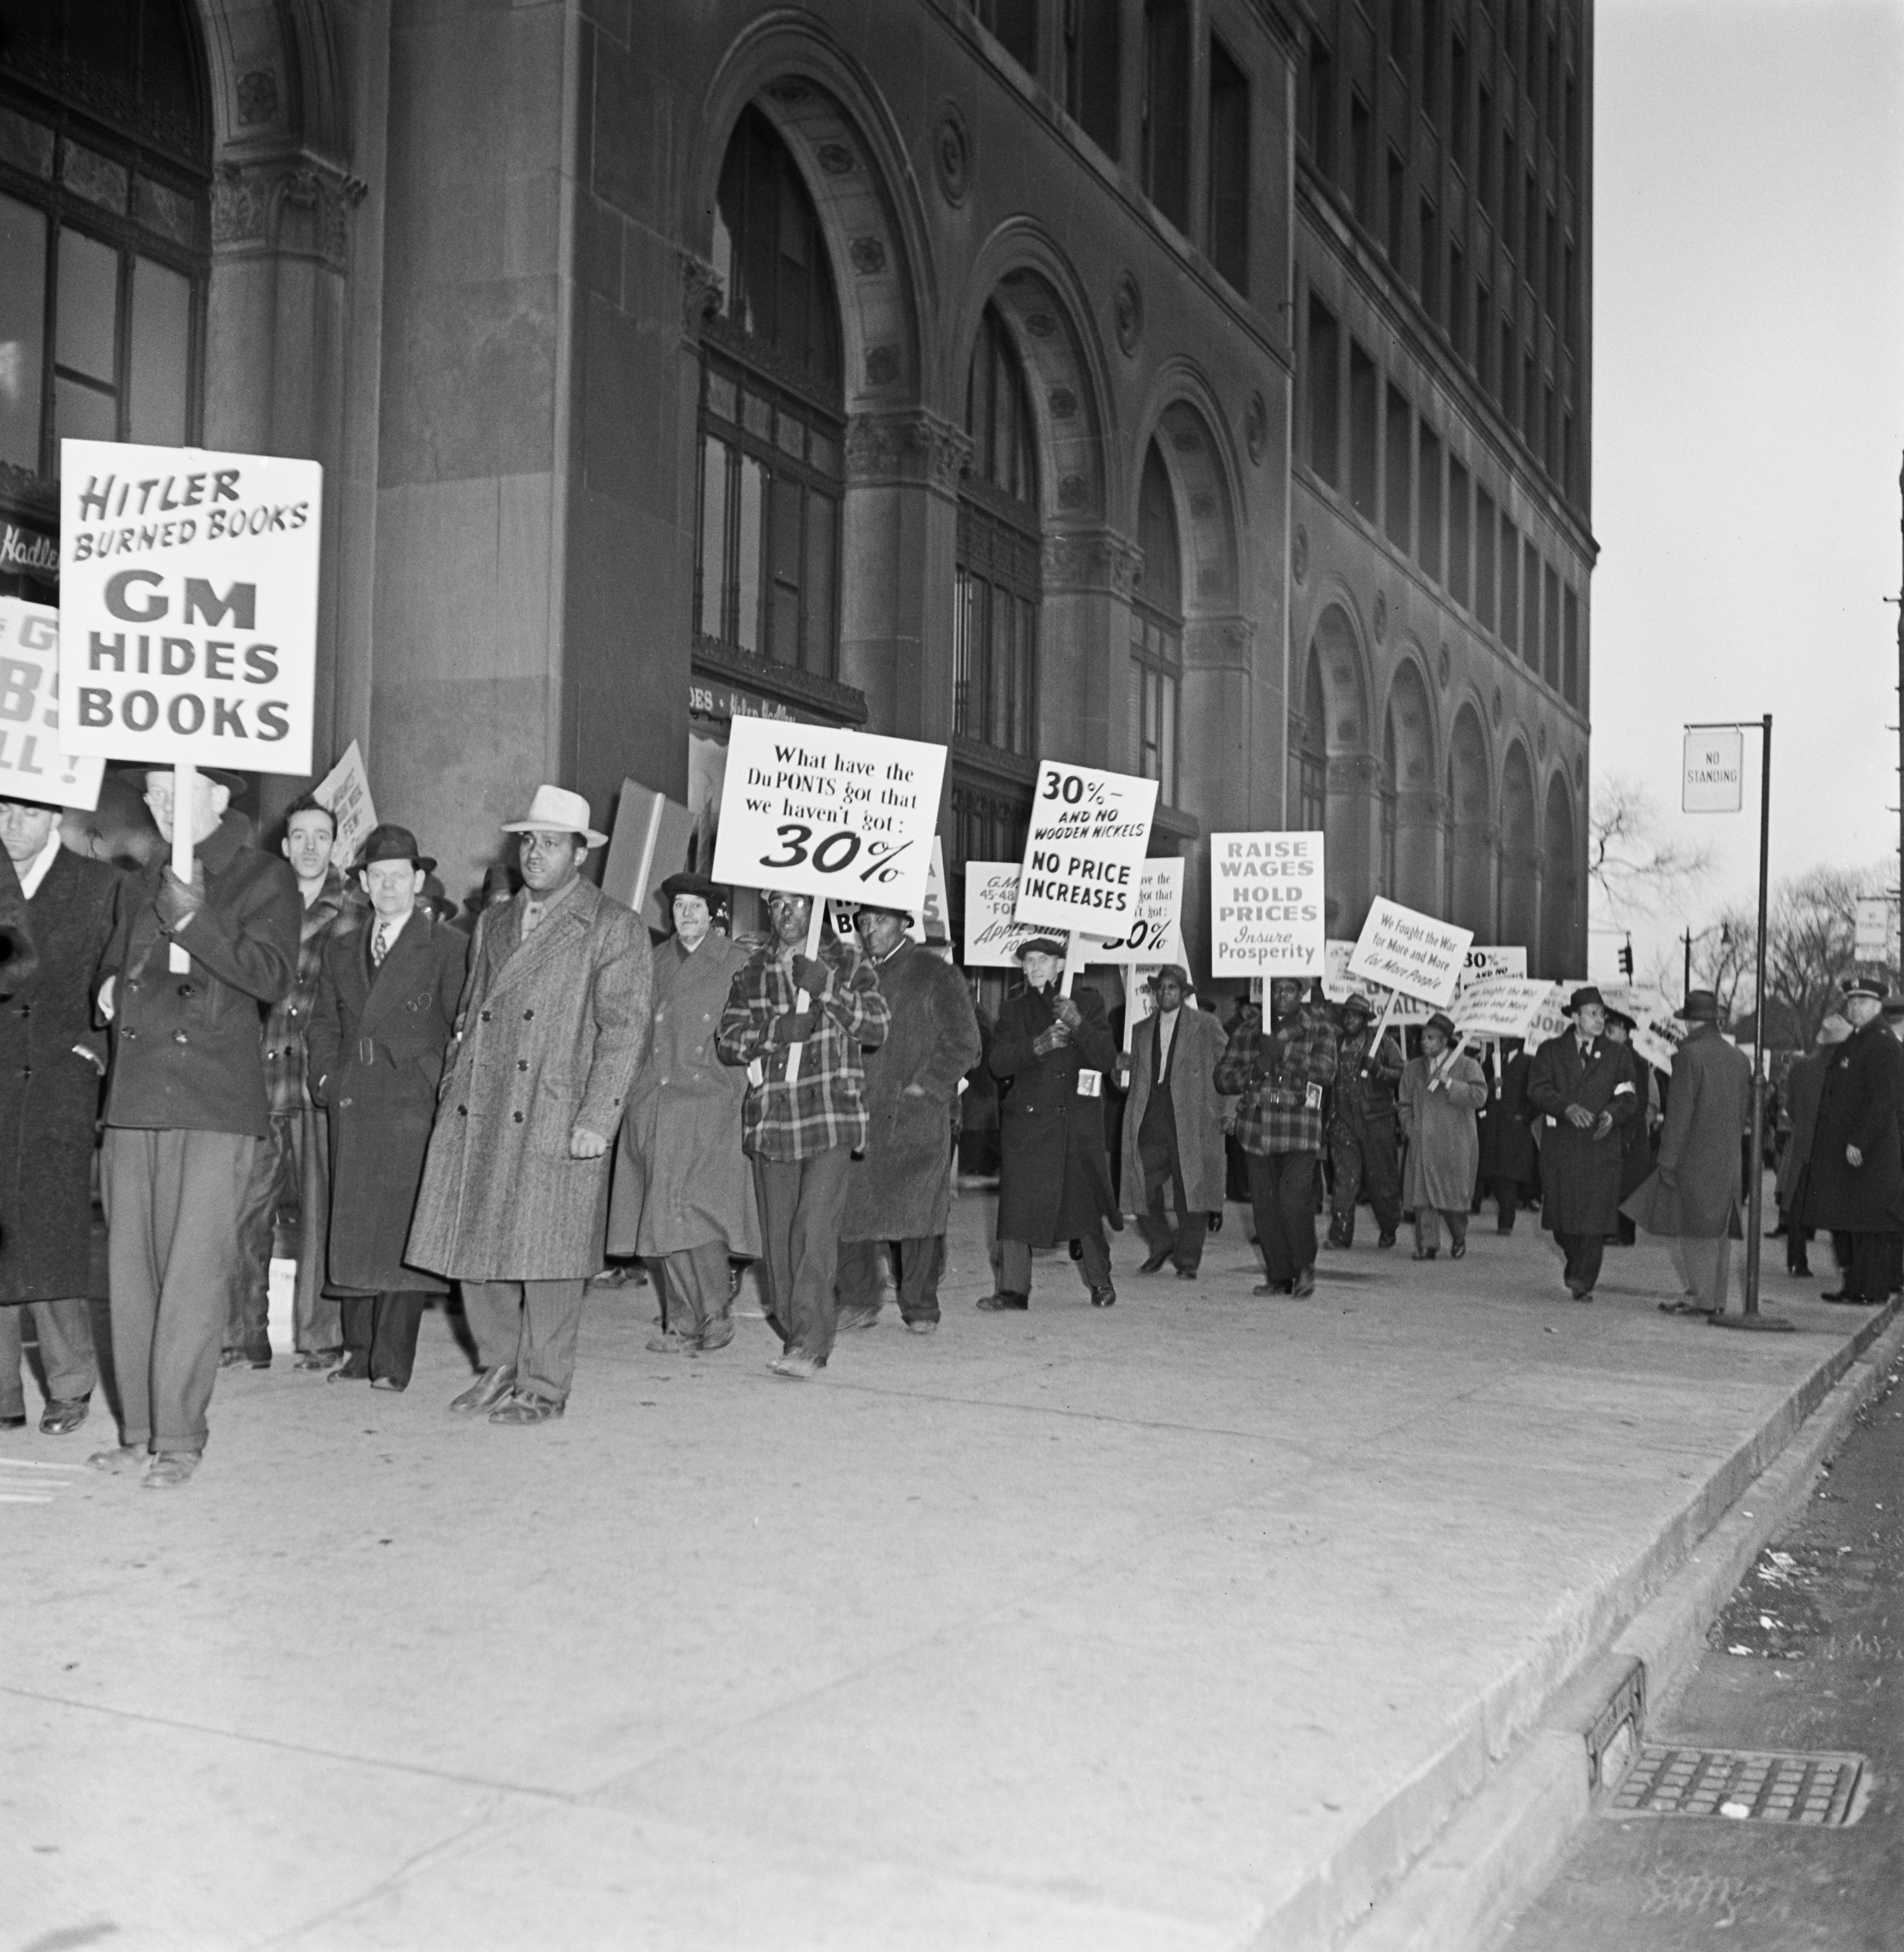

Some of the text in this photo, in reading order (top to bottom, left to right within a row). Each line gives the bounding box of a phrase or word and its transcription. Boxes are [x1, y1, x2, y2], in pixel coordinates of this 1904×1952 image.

[78, 469, 241, 522] HITLER
[73, 501, 309, 563] BURNED BOOKS
[0, 524, 60, 571] Hadle
[103, 569, 257, 631] GM
[88, 631, 280, 684] HIDES
[77, 686, 290, 742] BOOKS
[773, 743, 914, 782] What have the
[1706, 752, 1720, 764] NO
[1687, 769, 1737, 782] STANDING
[843, 782, 872, 805] got
[881, 789, 917, 809] that
[745, 798, 771, 814] we
[782, 798, 850, 825] haven't
[1059, 809, 1118, 824] AND NO
[1035, 823, 1145, 840] WOODEN NICKELS
[759, 824, 914, 883] 30%
[1228, 842, 1308, 858] RAISE
[1031, 850, 1131, 884] NO PRICE
[1220, 860, 1314, 877] WAGES
[1025, 877, 1127, 911] INCREASES
[1156, 888, 1172, 900] that
[1233, 886, 1302, 903] HOLD
[1219, 905, 1317, 921] PRICES
[973, 920, 1028, 945] APPLE
[1234, 925, 1292, 943] Insure
[1381, 912, 1394, 930] We
[1425, 930, 1439, 946] the
[1440, 935, 1458, 952] War
[1219, 942, 1315, 965] Prosperity
[1373, 933, 1450, 972] for More and More
[1475, 970, 1493, 979] AND
